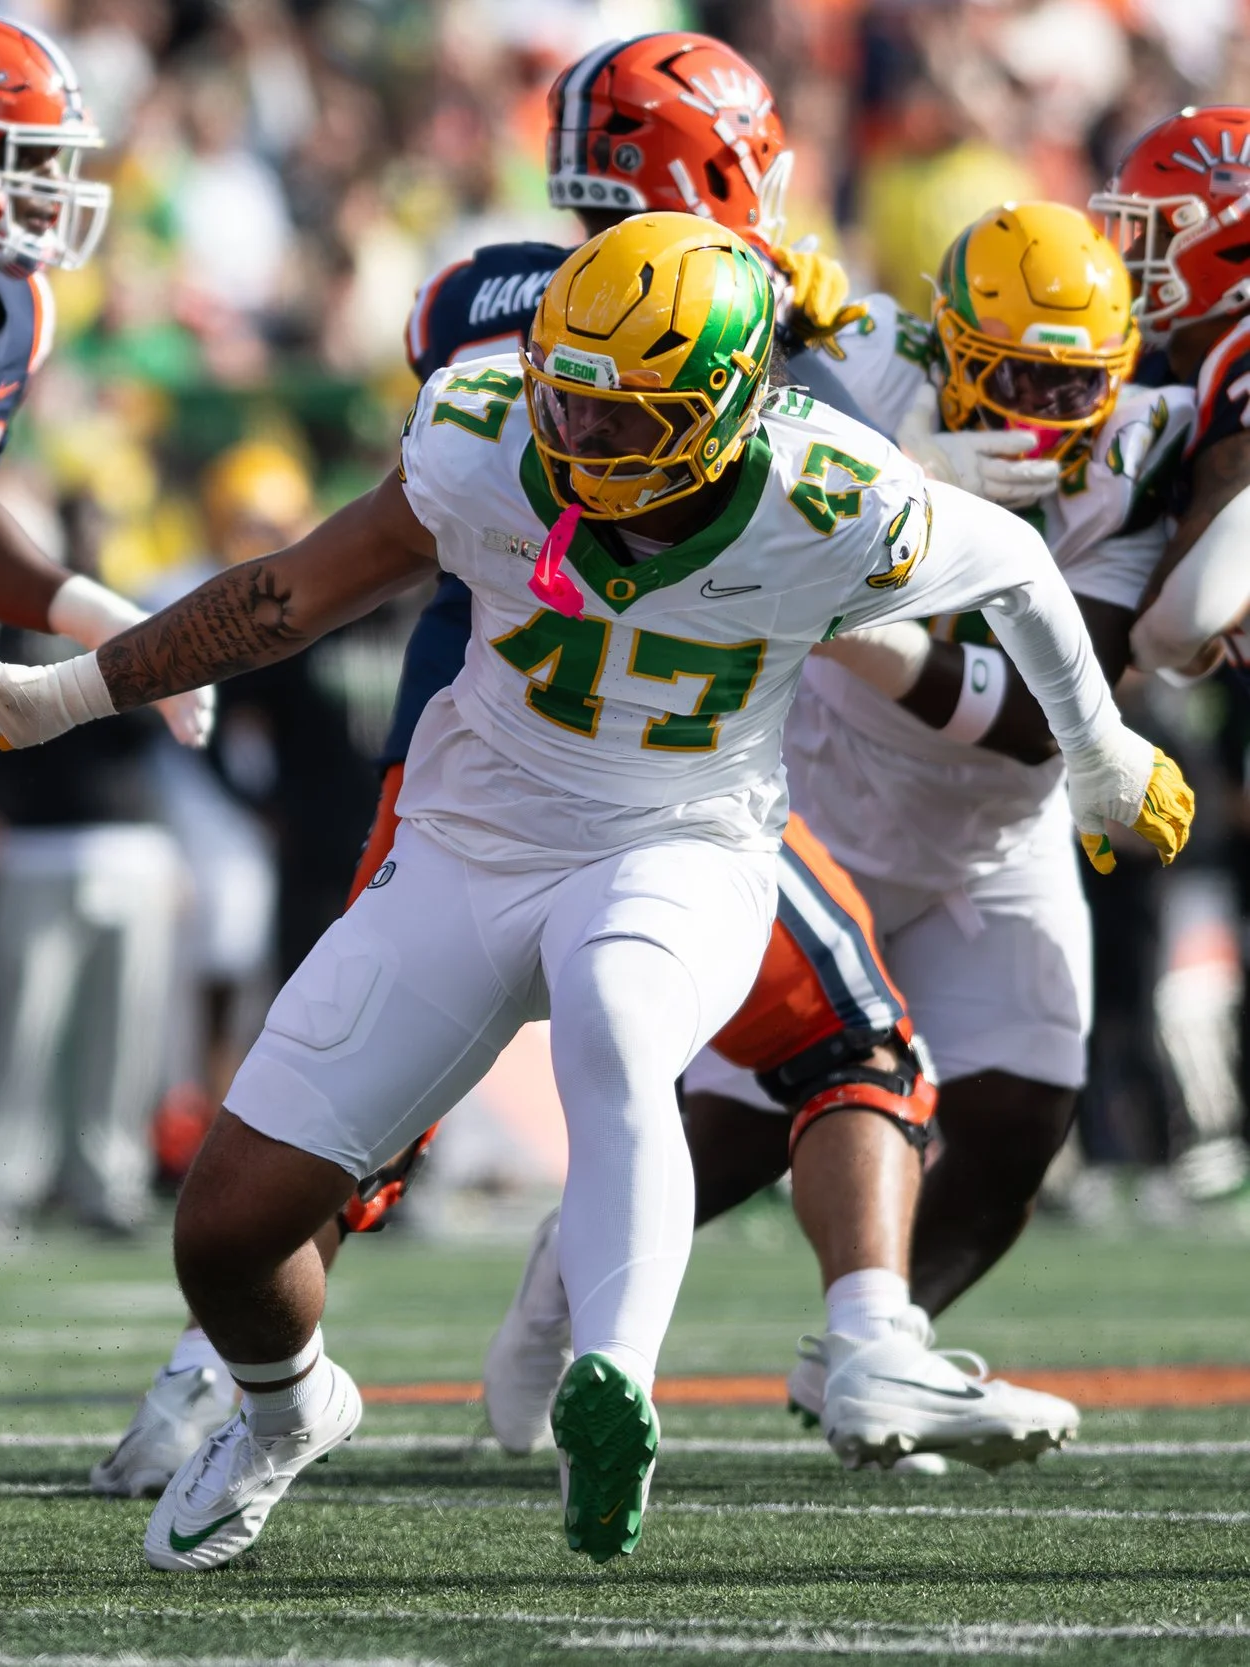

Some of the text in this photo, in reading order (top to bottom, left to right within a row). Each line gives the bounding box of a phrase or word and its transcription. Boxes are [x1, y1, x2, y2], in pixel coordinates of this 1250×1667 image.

[1171, 129, 1250, 174] ILLI
[553, 356, 598, 382] OREGON
[787, 441, 882, 538] 47
[489, 608, 768, 753] 47
